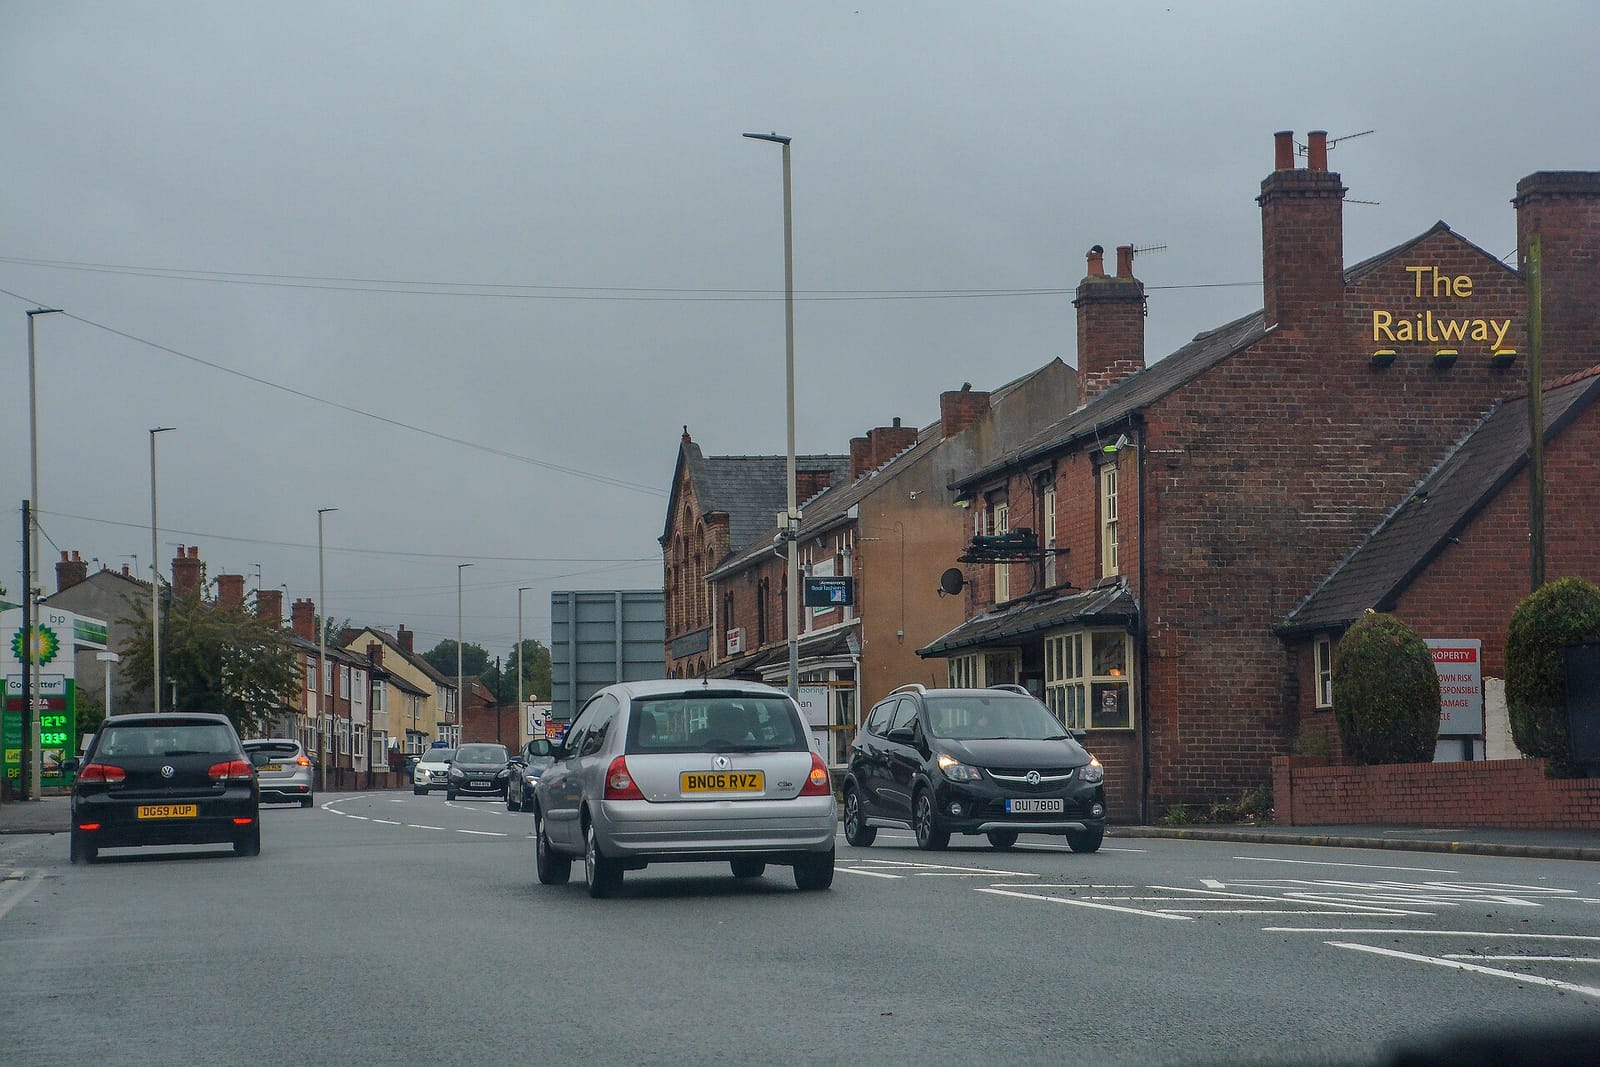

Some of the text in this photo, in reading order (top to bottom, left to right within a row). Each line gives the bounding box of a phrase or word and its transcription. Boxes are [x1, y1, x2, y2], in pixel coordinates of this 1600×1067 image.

[1405, 266, 1473, 298] The
[1373, 310, 1511, 351] Railway
[49, 613, 65, 625] bp
[1431, 651, 1470, 660] ROPERTY
[1457, 673, 1473, 682] RISK
[1439, 686, 1479, 695] ESPONSIBLE
[687, 774, 757, 789] BN06 RVZ
[143, 806, 192, 817] DG59 AUP
